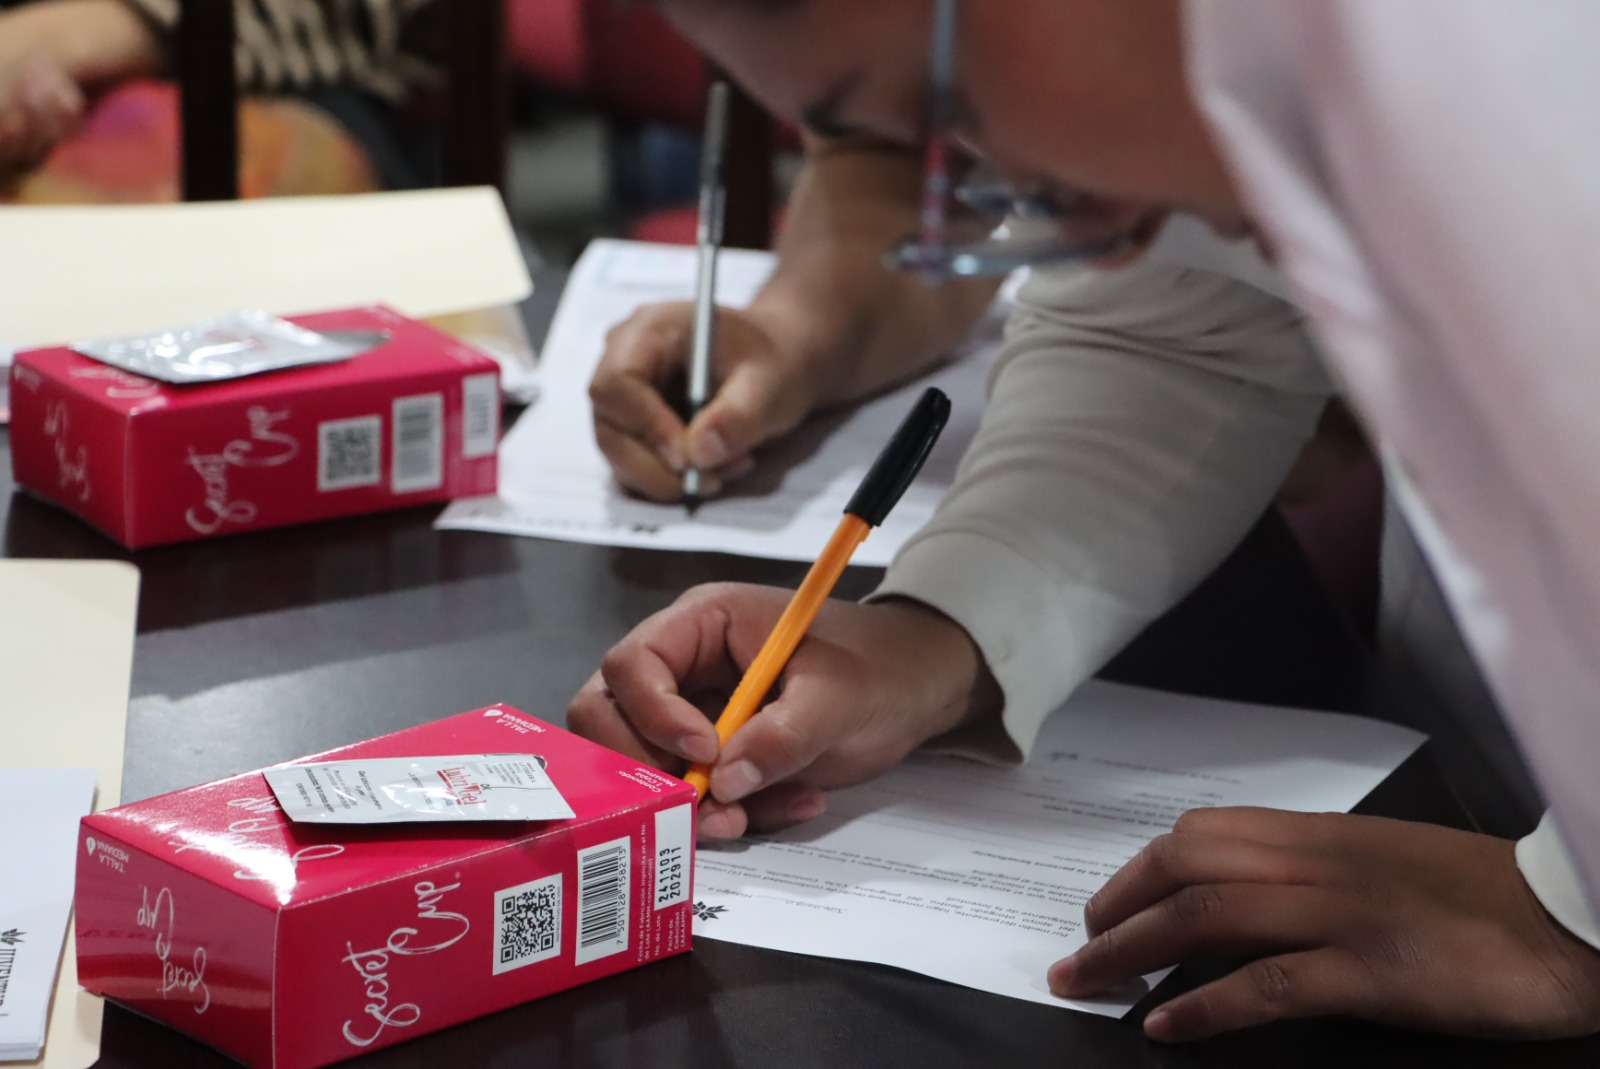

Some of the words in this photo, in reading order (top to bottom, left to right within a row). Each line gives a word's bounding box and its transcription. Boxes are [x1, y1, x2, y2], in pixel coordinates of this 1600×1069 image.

[496, 718, 530, 734] TALLA
[503, 713, 547, 733] MEDIANA
[634, 767, 678, 787] Menstrual
[635, 772, 657, 784] Copa
[97, 839, 130, 863] MEDIANA
[100, 852, 125, 873] TALLA
[658, 848, 670, 903] 241103
[669, 846, 682, 899] 202911
[639, 926, 644, 936] de
[642, 843, 646, 853] en
[854, 885, 901, 897] programa
[980, 883, 1011, 892] apoyo
[925, 904, 950, 913] hago
[930, 900, 963, 910] dentro
[953, 910, 999, 922] presente,
[969, 907, 1015, 919] otorgado
[1021, 911, 1081, 926] Hidalguense
[668, 918, 673, 930] de
[1018, 923, 1050, 933] medio
[1022, 917, 1052, 927] apoyo
[655, 931, 661, 941] de
[644, 950, 649, 960] de
[341, 940, 421, 1047] Secret
[386, 881, 470, 955] Cup
